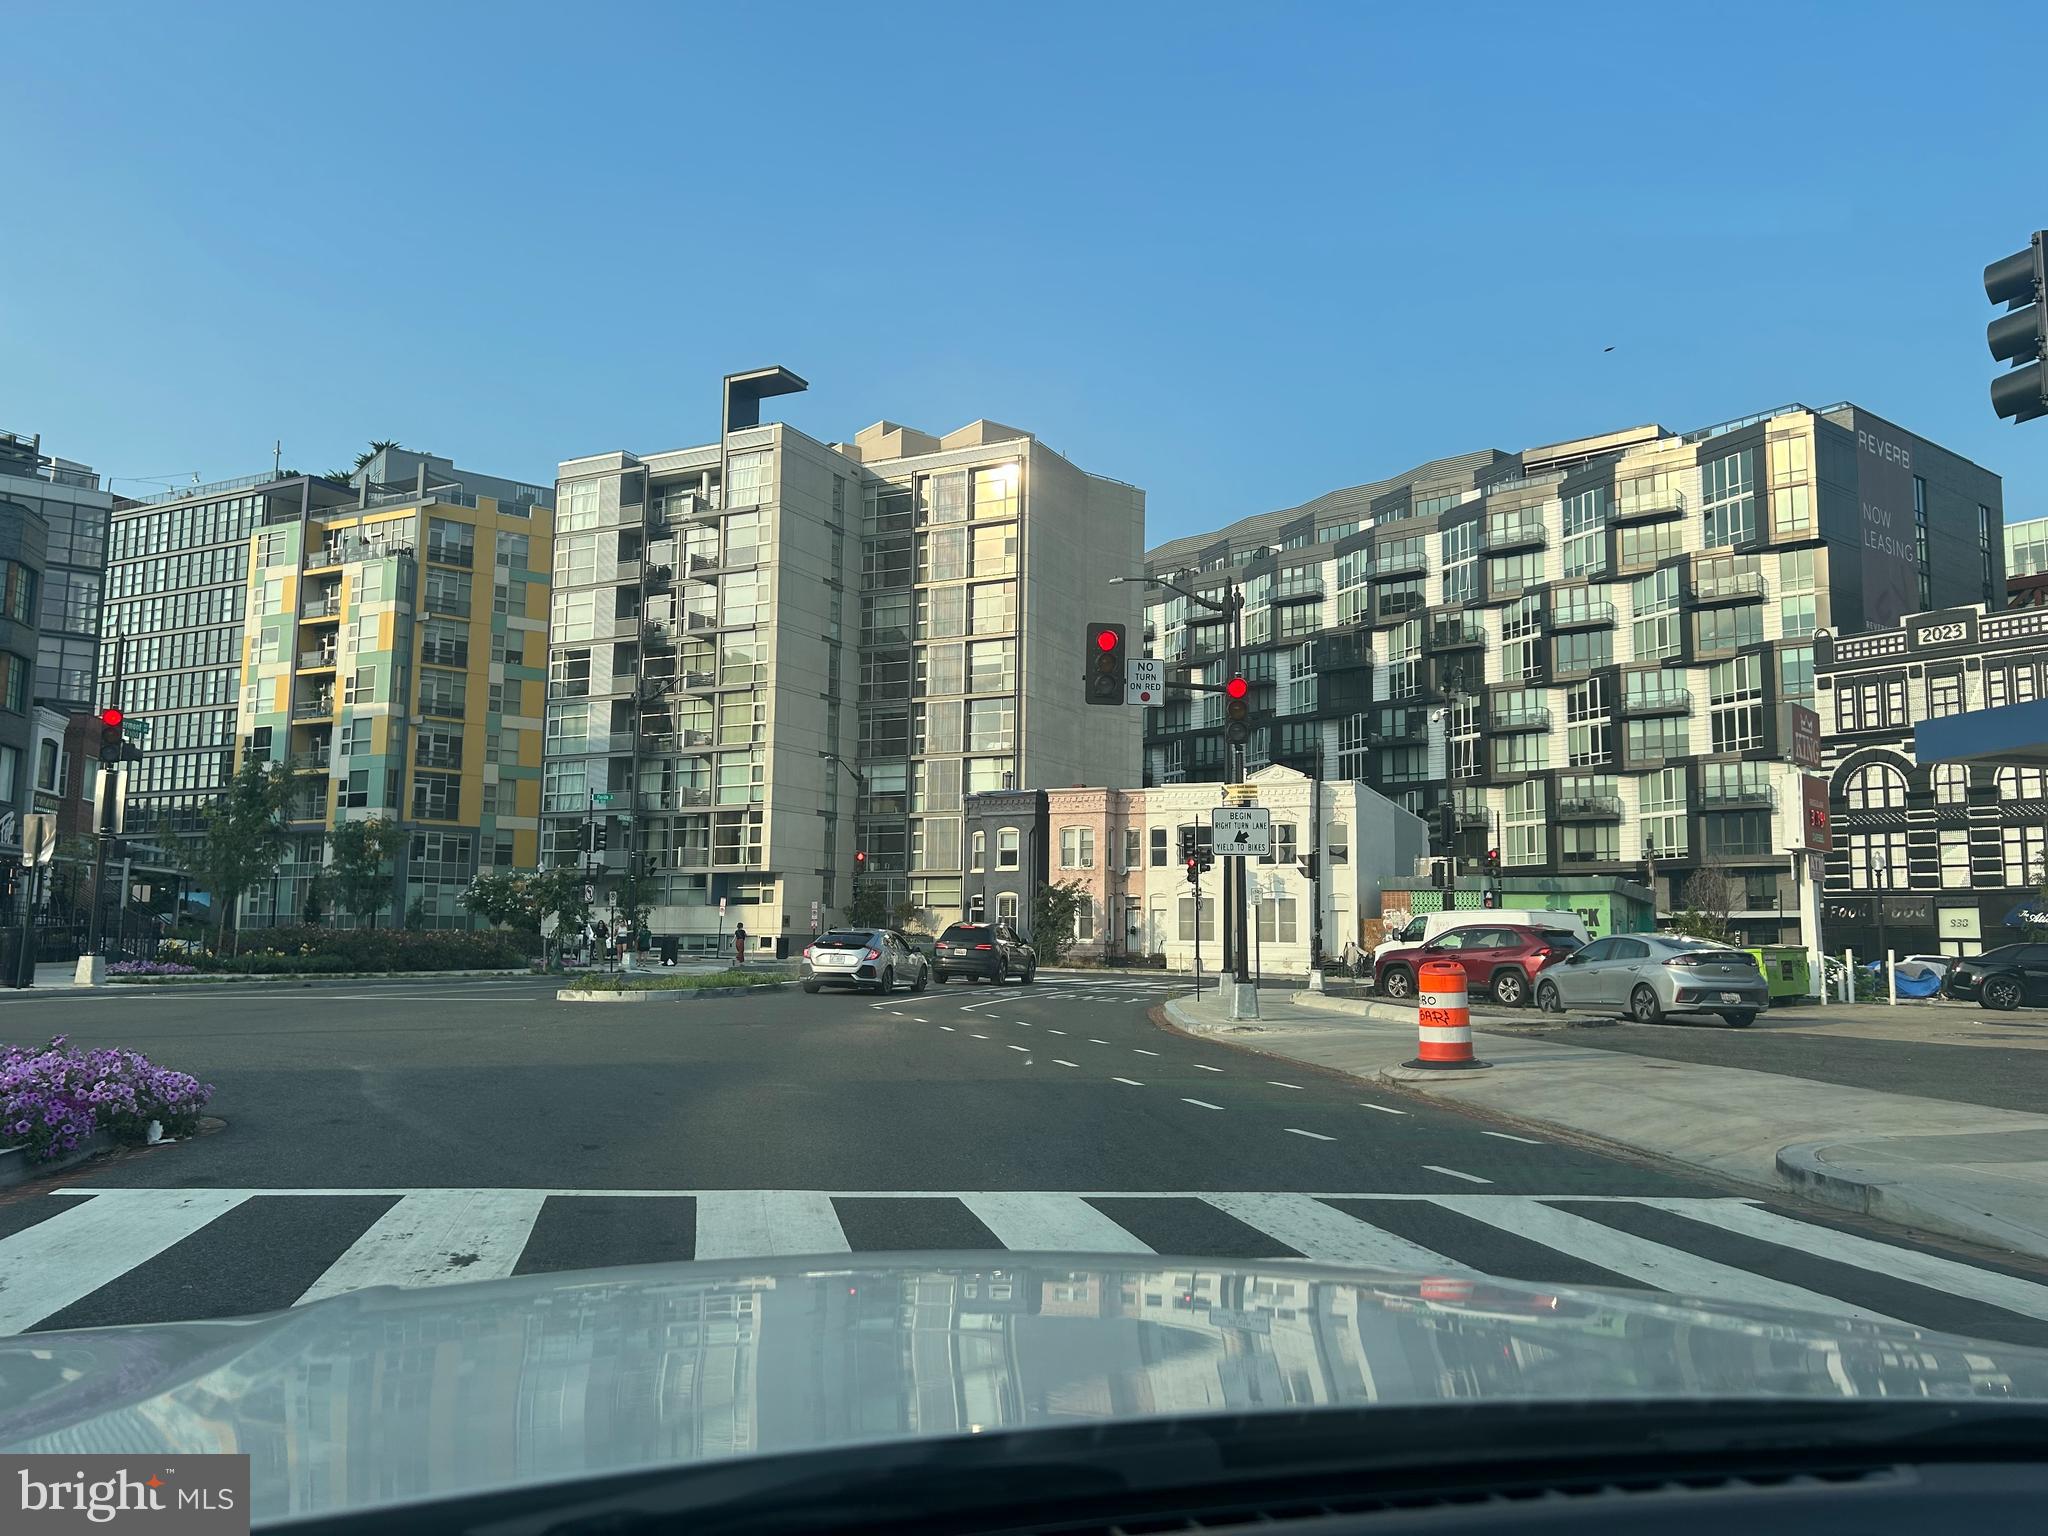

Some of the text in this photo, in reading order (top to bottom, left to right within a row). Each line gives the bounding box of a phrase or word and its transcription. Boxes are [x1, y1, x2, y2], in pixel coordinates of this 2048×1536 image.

[1858, 430, 1910, 469] REVERB
[1863, 502, 1891, 529] NOW
[1864, 528, 1913, 562] LEASING
[1922, 624, 1963, 643] 2023
[1137, 662, 1154, 671] NO
[1135, 673, 1157, 681] TURN
[1130, 682, 1161, 691] ON RED
[1795, 732, 1819, 763] KING
[1229, 812, 1252, 820] BEGIN
[1216, 843, 1266, 851] YIELD TO BIKES
